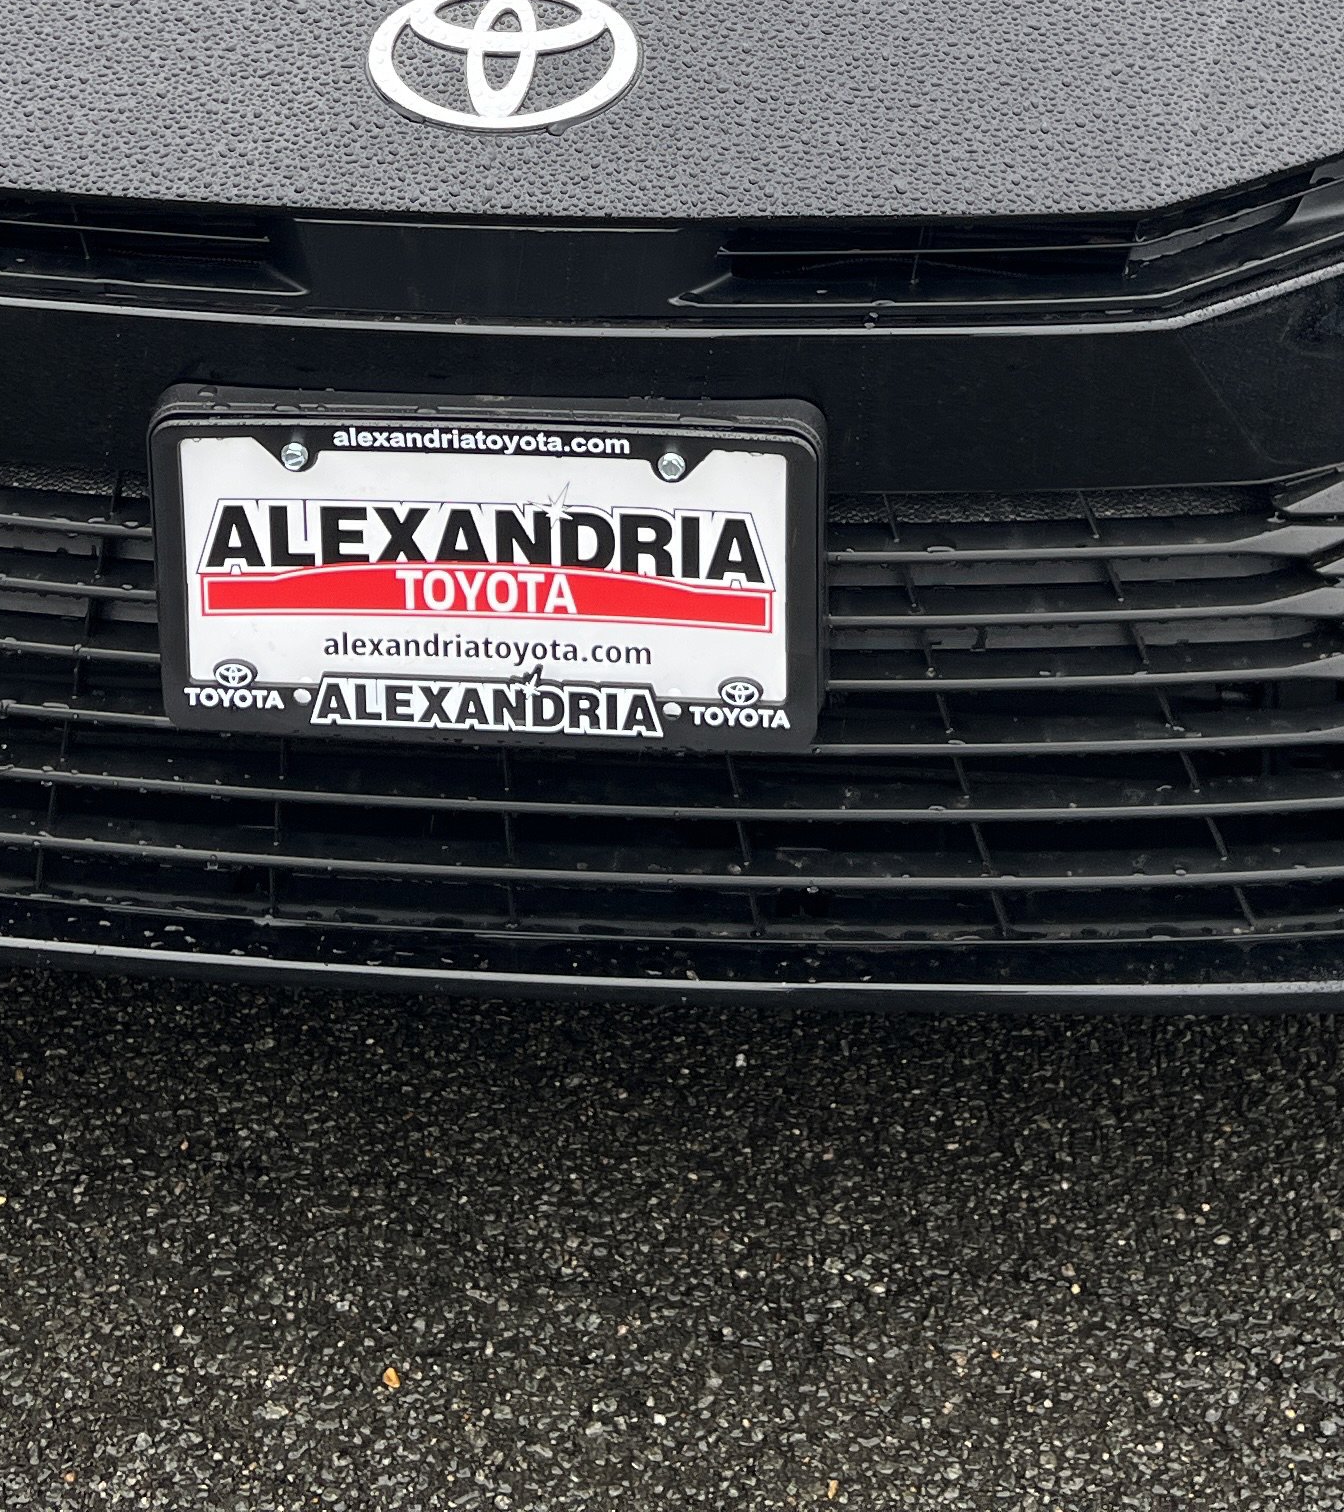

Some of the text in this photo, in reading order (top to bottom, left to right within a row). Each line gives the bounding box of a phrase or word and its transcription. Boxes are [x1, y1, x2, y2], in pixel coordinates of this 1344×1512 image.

[333, 428, 631, 455] alexandriatoyota.com
[203, 501, 770, 587] ALEXANDRIA
[395, 569, 578, 615] TOYOTA
[323, 631, 653, 666] alexandriatoyota.com
[183, 676, 791, 736] TOYOTA ALEXANDRIA TOYOTA
